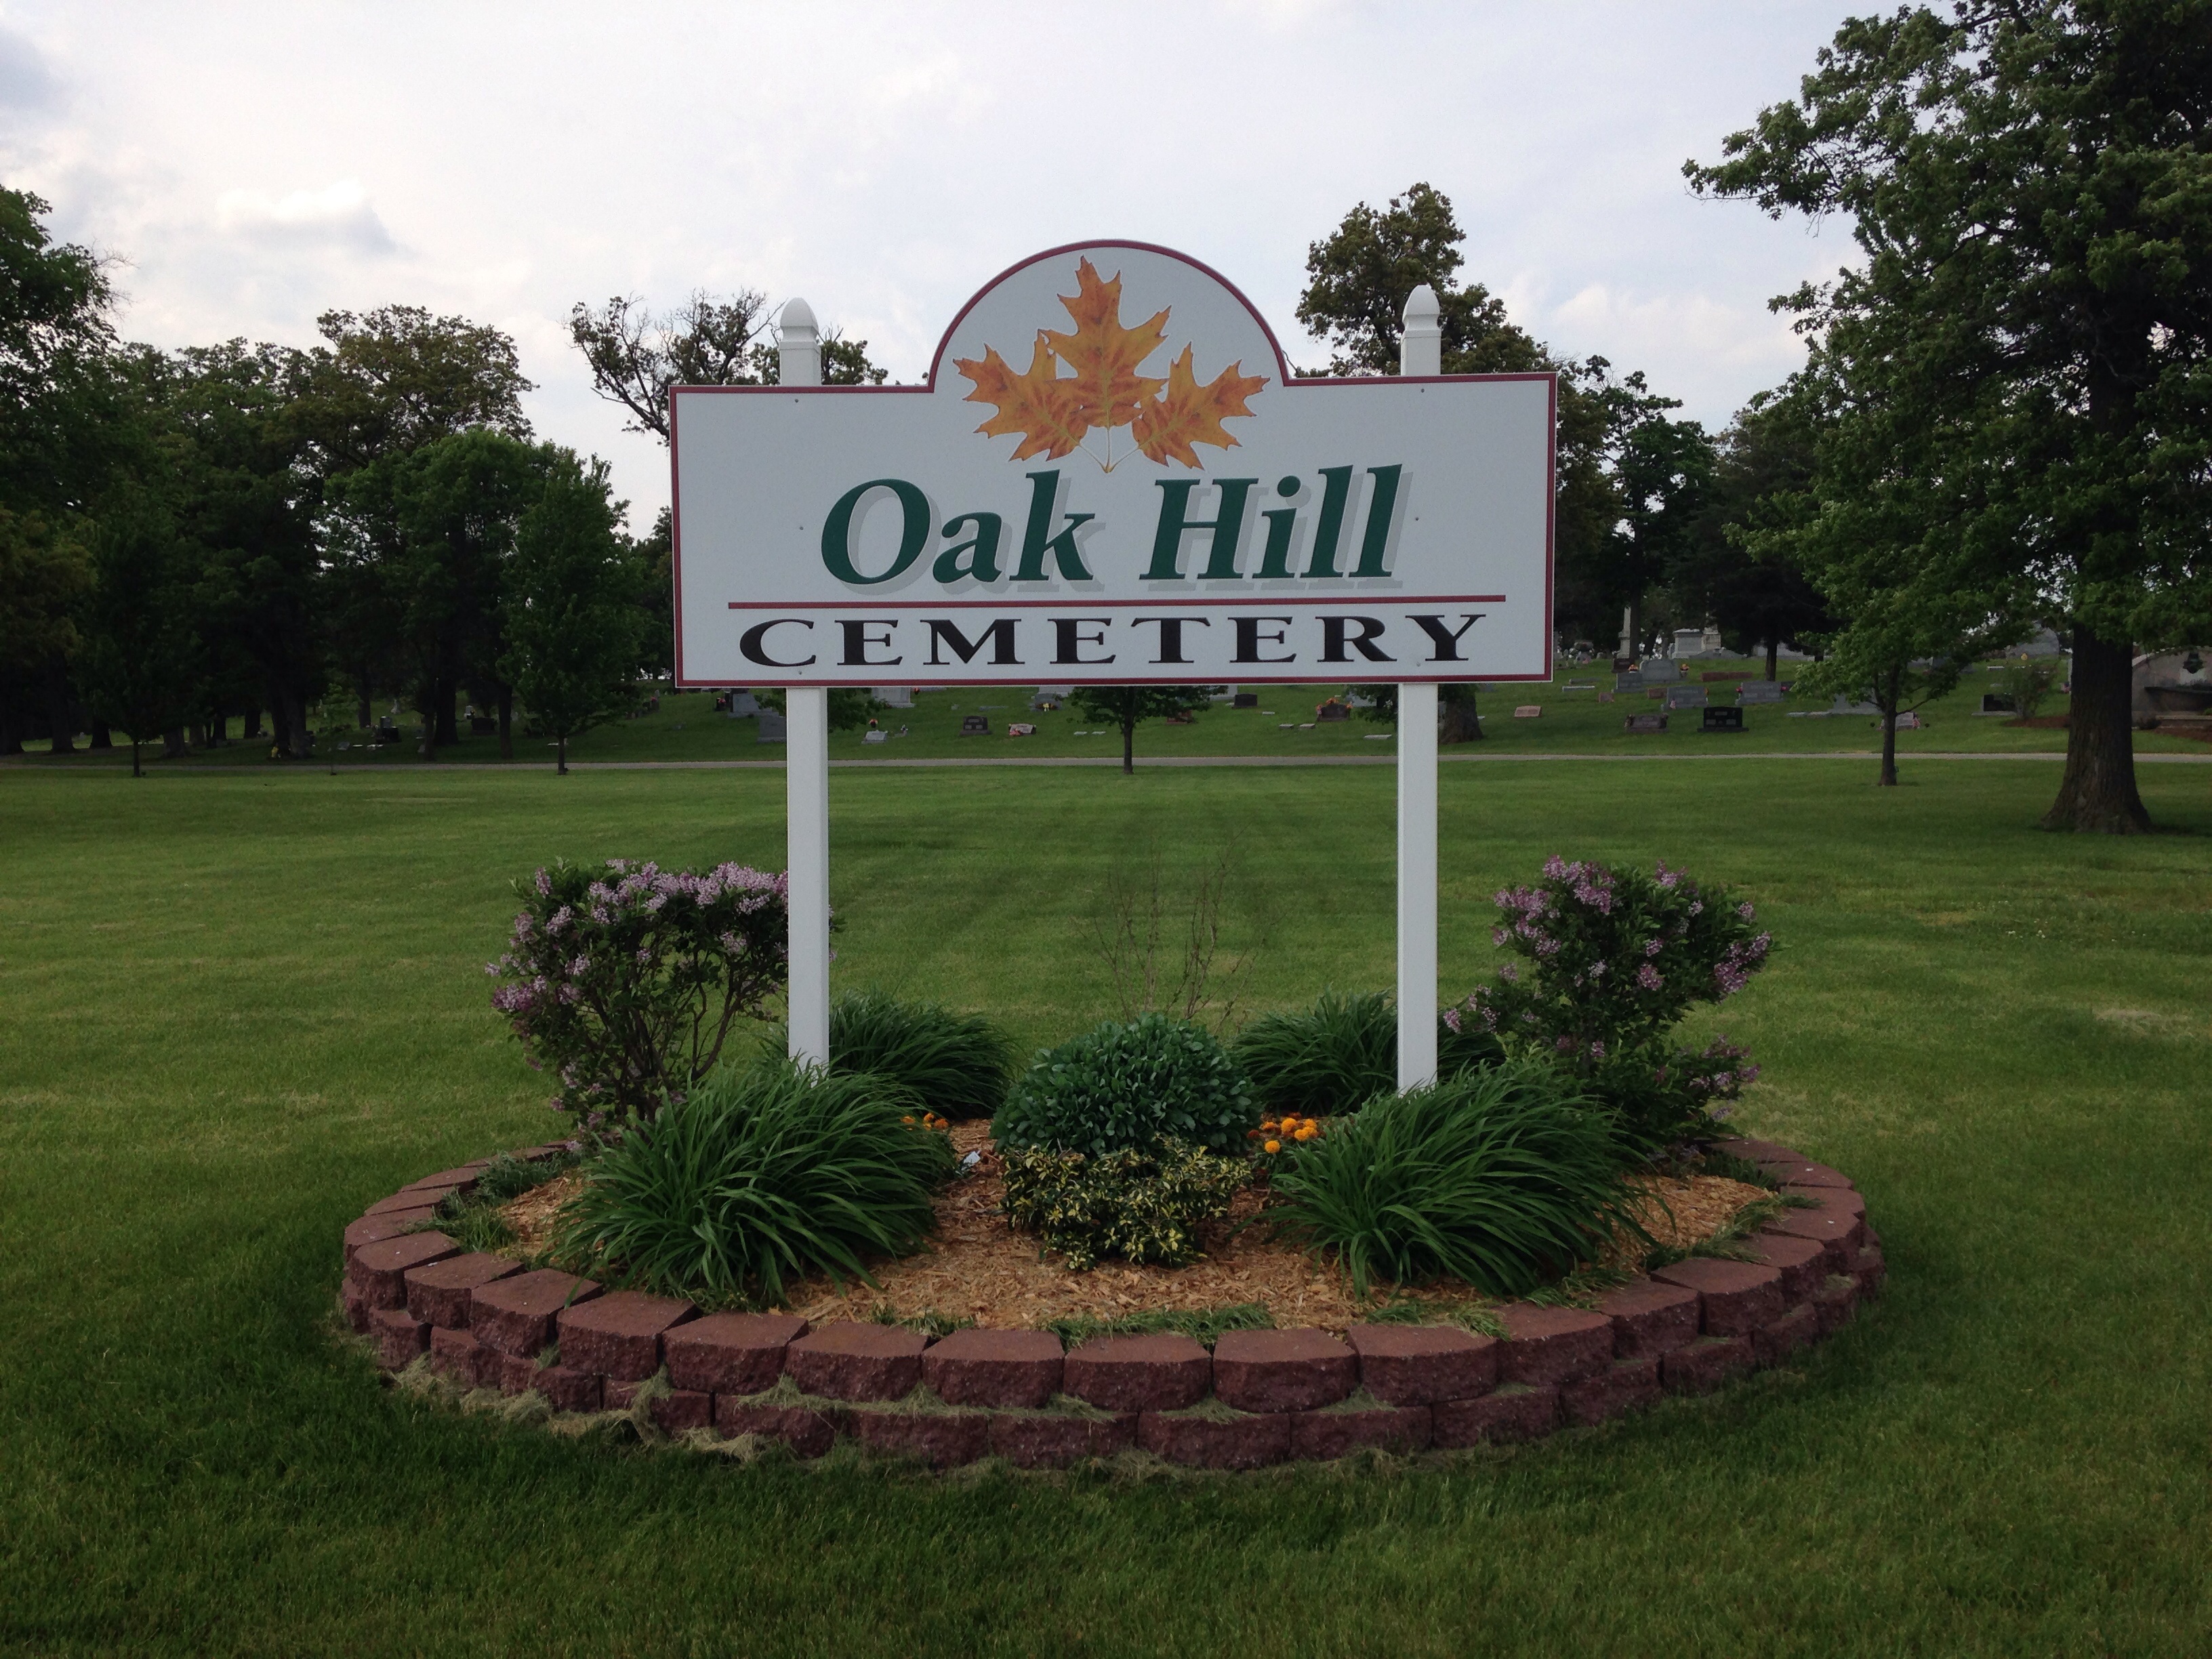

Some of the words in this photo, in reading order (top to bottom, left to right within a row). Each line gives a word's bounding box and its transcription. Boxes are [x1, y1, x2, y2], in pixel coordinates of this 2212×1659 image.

[820, 468, 1097, 586] Oak
[1139, 462, 1404, 581] Hill
[739, 613, 1488, 668] CEMETERY
